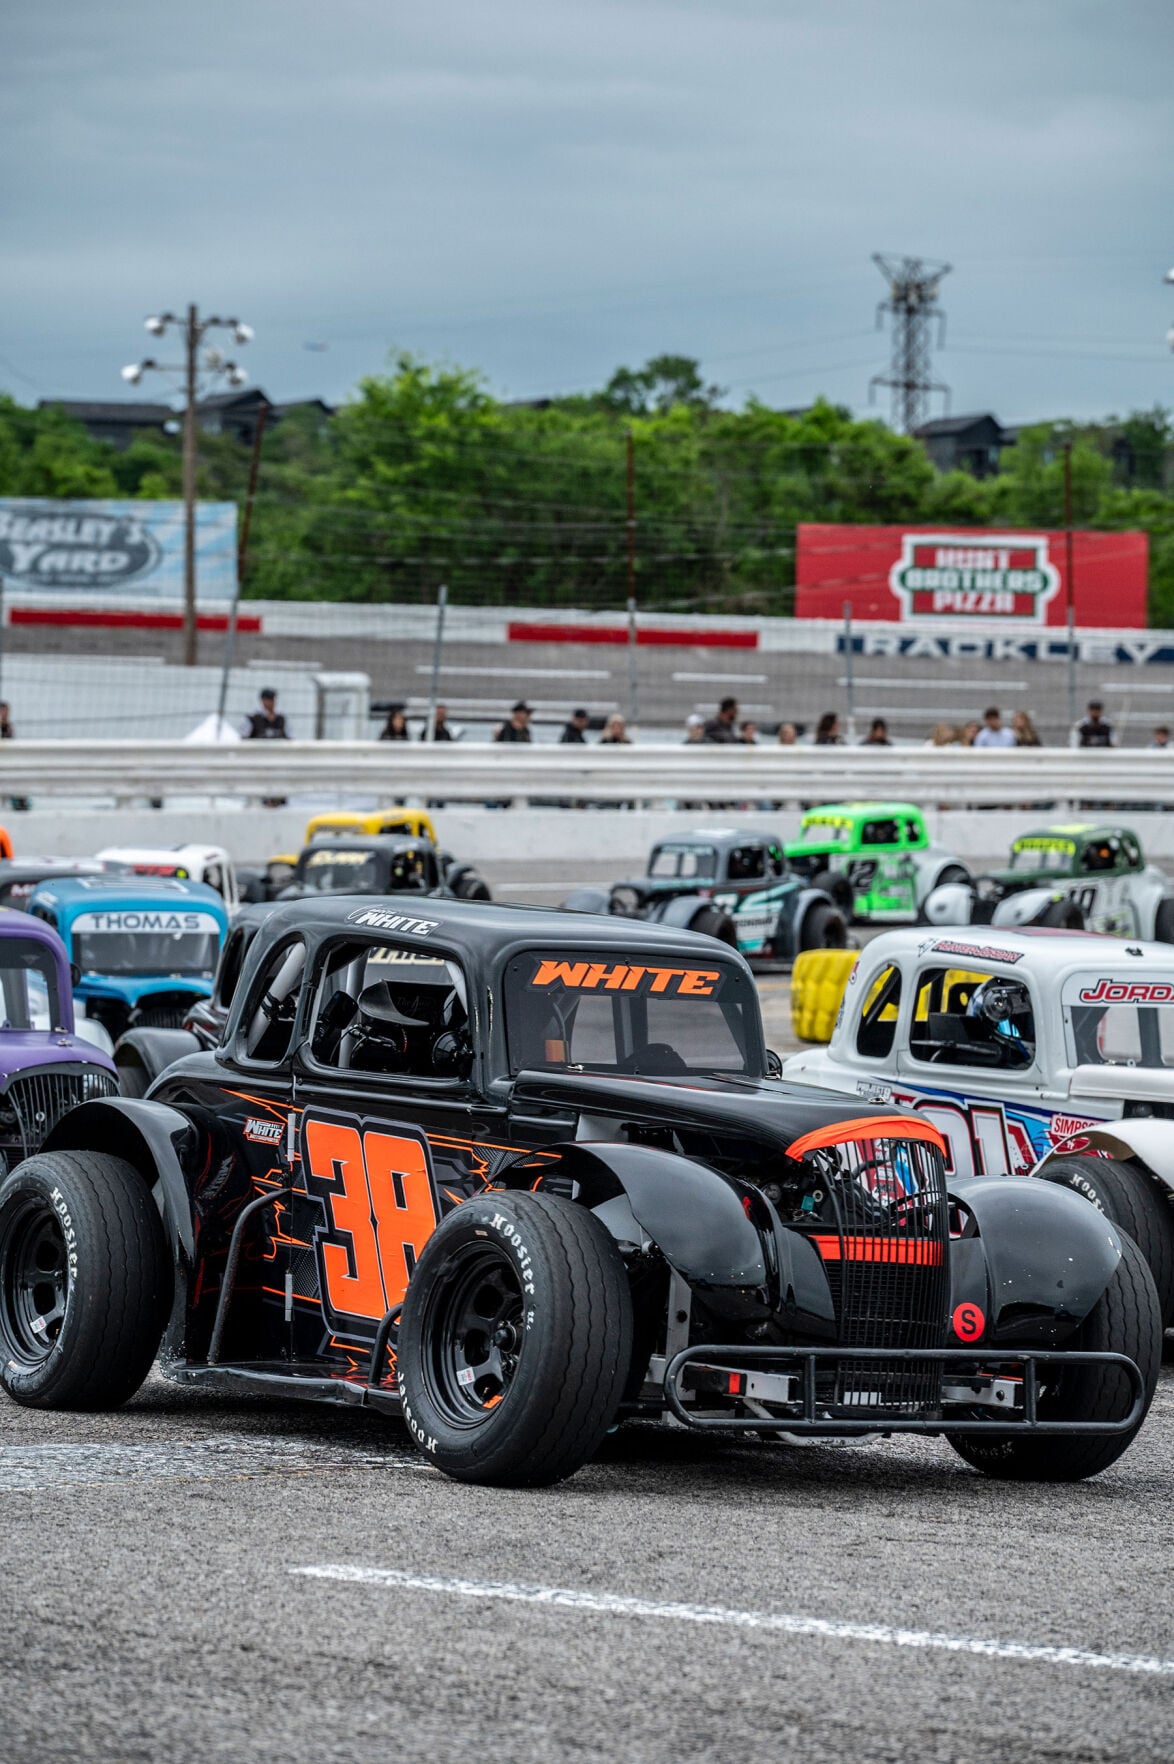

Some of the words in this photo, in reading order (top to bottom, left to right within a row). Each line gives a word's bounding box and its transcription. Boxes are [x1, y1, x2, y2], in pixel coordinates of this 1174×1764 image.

[904, 569, 1044, 592] BROTHERS
[933, 591, 1015, 613] PIZZA
[863, 636, 1160, 664] RACKLEY
[91, 914, 200, 929] THOMAS
[355, 911, 440, 935] WHITE
[532, 960, 720, 995] WHITE
[1081, 981, 1174, 1002] JORD
[245, 1119, 282, 1139] WHITE
[50, 1186, 78, 1278] Hoosier
[306, 1119, 436, 1325] 38
[489, 1213, 535, 1295] Hoosier
[961, 1309, 977, 1335] S
[397, 1371, 439, 1454] Hoosier
